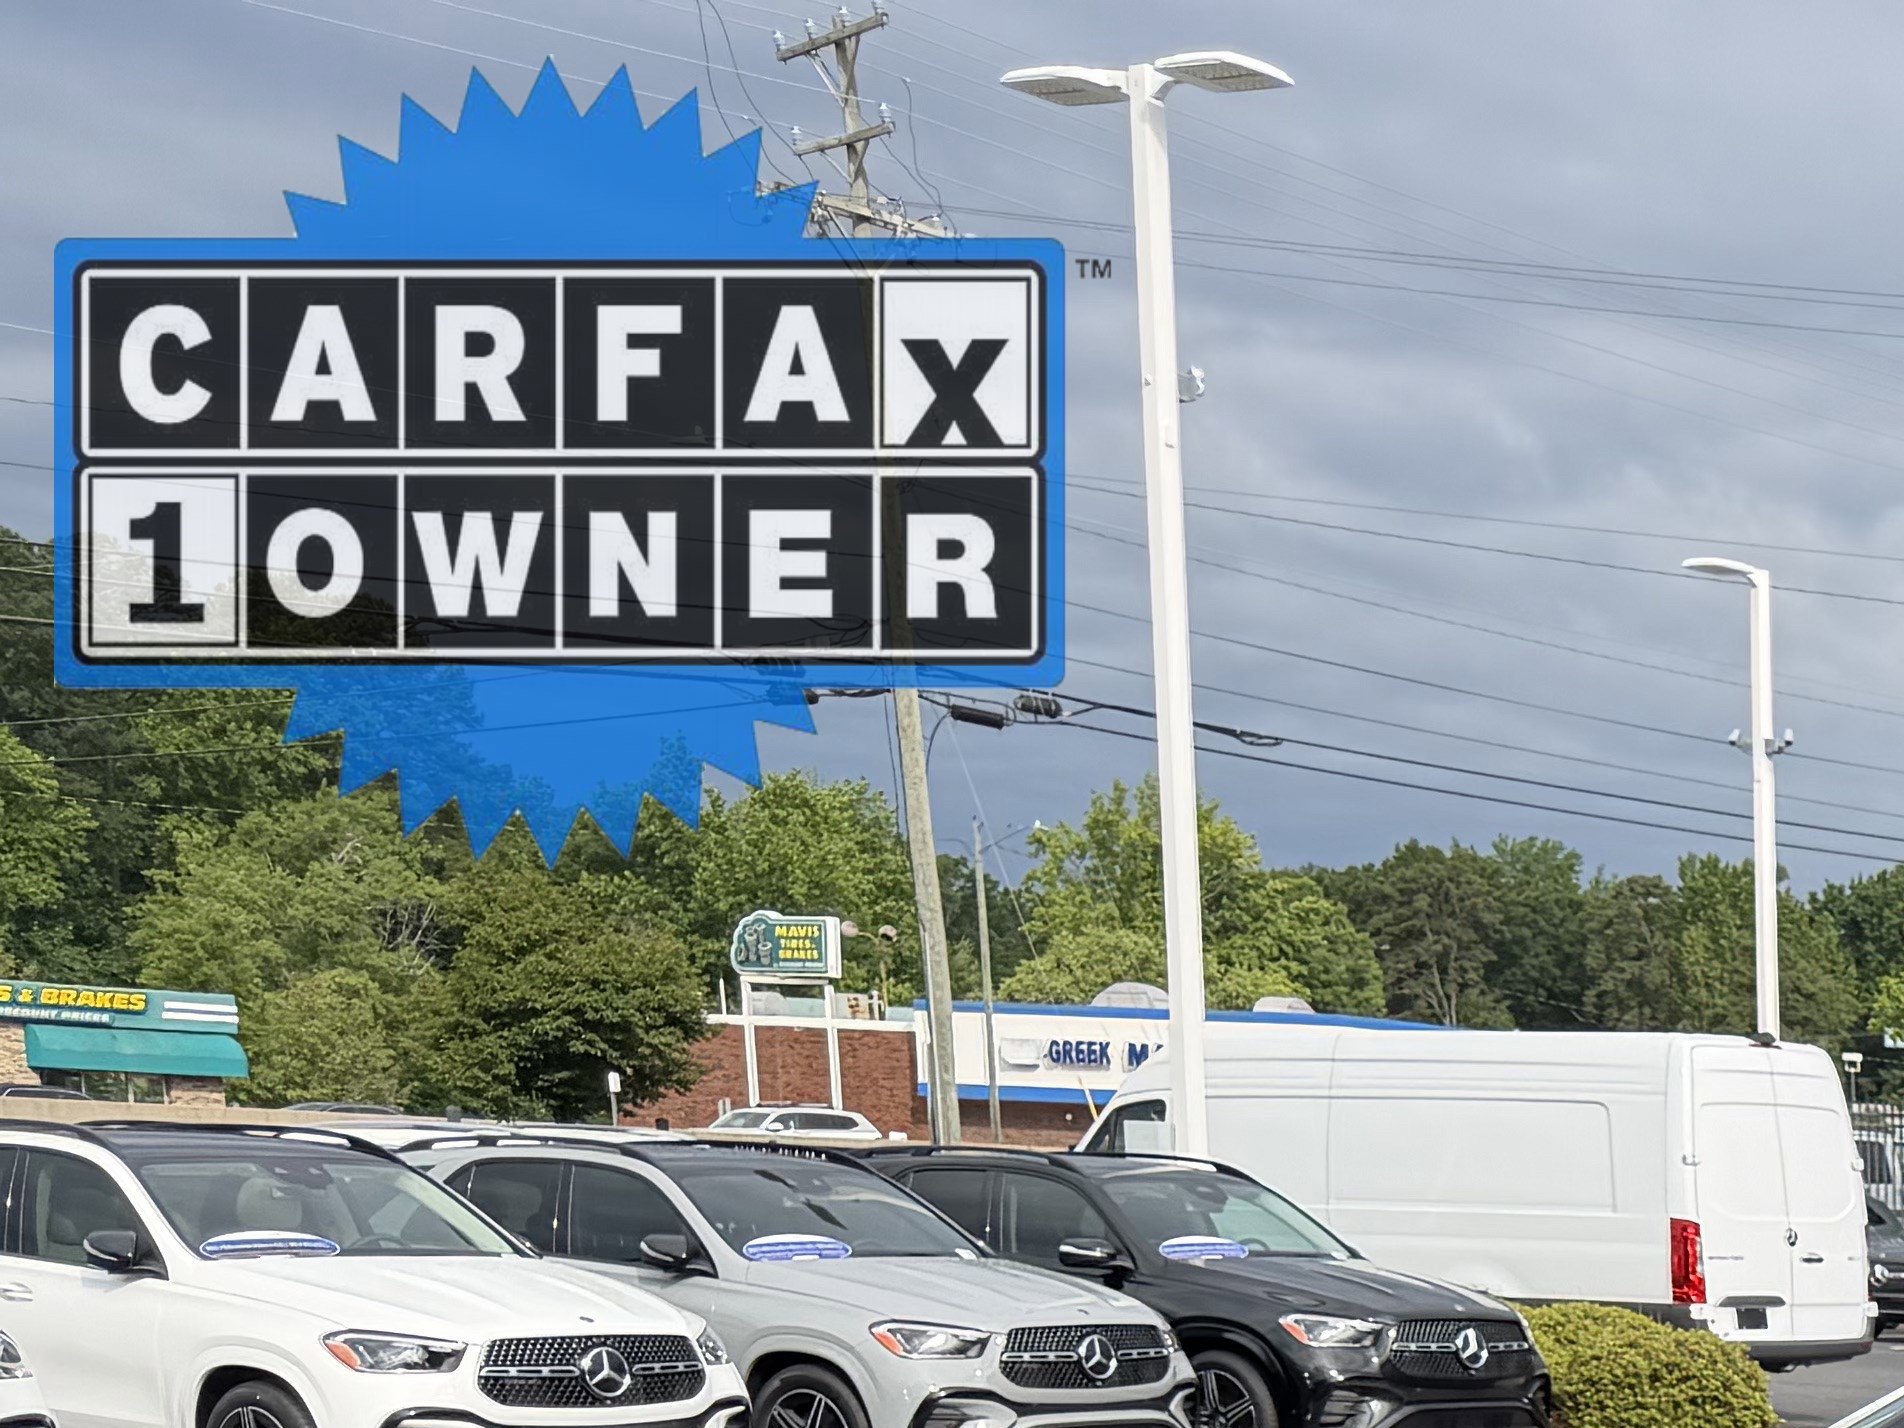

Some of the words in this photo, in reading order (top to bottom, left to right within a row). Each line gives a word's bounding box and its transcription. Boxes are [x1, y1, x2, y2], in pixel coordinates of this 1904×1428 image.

[774, 925, 820, 937] MAVIS
[18, 988, 34, 1003] &
[40, 988, 147, 1011] BRAKES
[1049, 1040, 1112, 1067] GREEK
